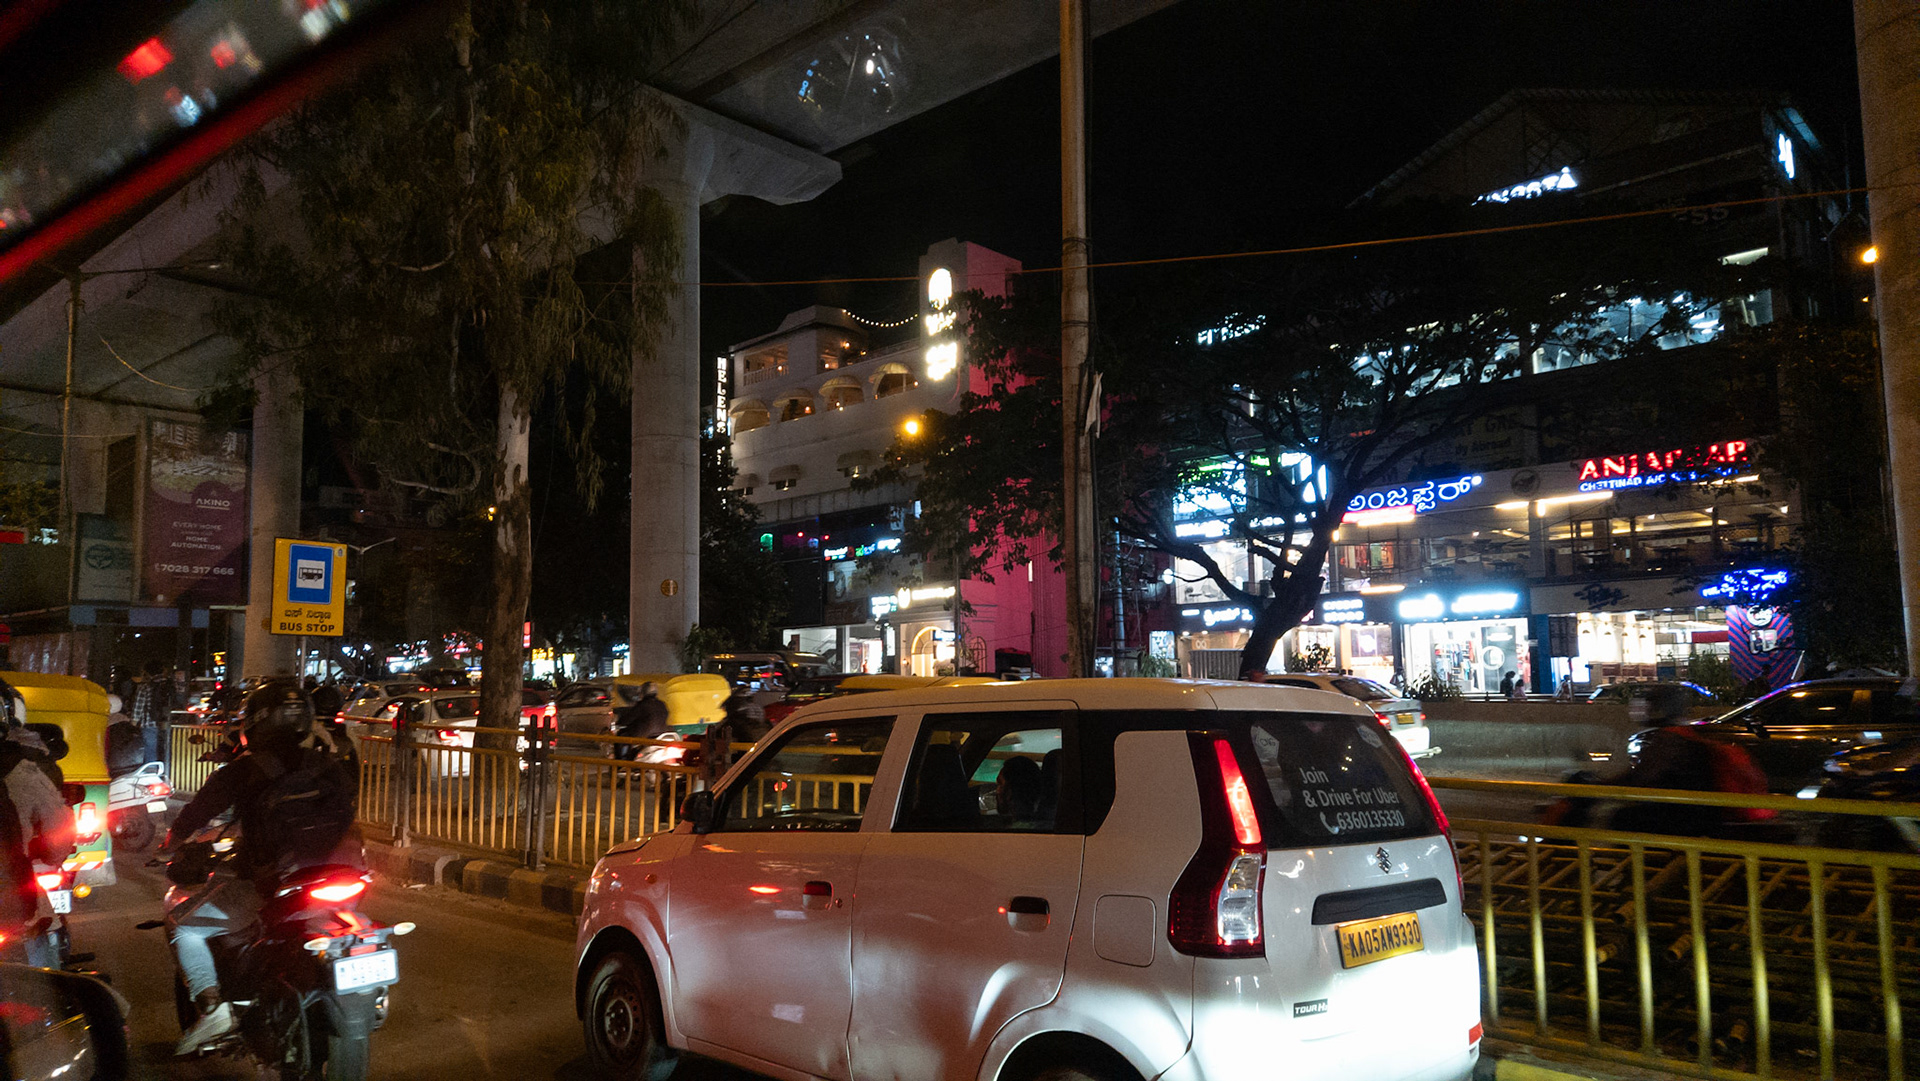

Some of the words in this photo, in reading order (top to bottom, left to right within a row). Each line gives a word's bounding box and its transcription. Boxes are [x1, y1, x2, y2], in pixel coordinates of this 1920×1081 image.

[195, 498, 231, 507] AKINO
[185, 535, 209, 543] HOME
[170, 542, 221, 550] AUTOMATION
[160, 564, 190, 573] 7028
[192, 566, 211, 574] 317
[213, 567, 235, 576] 666
[279, 622, 303, 632] BUS
[306, 623, 335, 633] STOP
[1299, 766, 1329, 785] Join
[1302, 790, 1318, 808] &
[1317, 788, 1354, 807] Drive
[1353, 787, 1373, 805] For
[1374, 787, 1400, 804] Uber
[1336, 809, 1405, 830] 6360135330
[1295, 1004, 1318, 1015] TOUR
